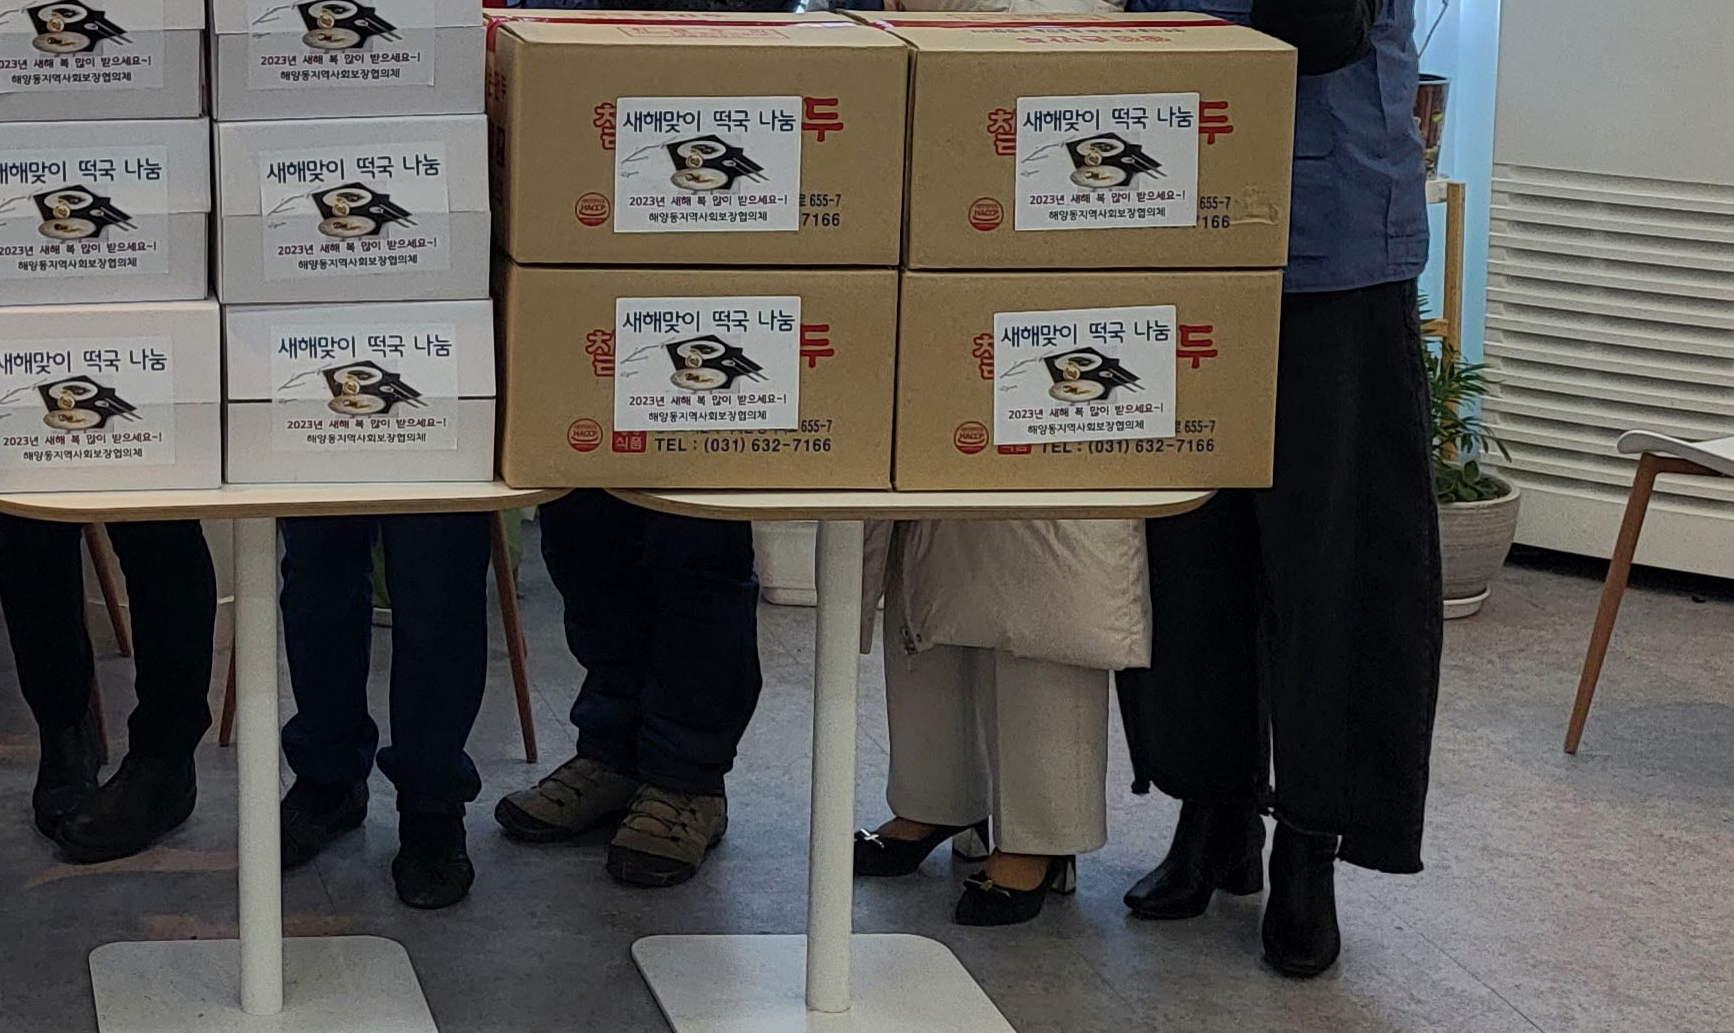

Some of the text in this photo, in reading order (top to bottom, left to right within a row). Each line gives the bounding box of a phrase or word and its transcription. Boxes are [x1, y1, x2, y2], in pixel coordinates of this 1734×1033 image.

[33, 58, 55, 69] 새해
[59, 56, 69, 69] 복
[73, 56, 96, 69] 많이
[11, 72, 132, 86] 해양동지역사회보장협의체
[622, 110, 701, 134] 새해맞이
[713, 109, 751, 133] 떡국
[759, 109, 797, 133] 나눔
[1022, 108, 1100, 133] 새해맞이
[1112, 107, 1149, 131] 떡국
[1157, 106, 1194, 129] 나눔
[78, 159, 117, 183] 떡국
[125, 158, 163, 181] 나눔
[266, 154, 442, 184] 새해맞이 떡국 나눔
[809, 193, 842, 207] 655-7
[1199, 195, 1232, 209] 655-7
[1049, 207, 1166, 222] 해양동지역사회보장협의체
[622, 309, 796, 334] 새해맞이 떡국 나눔
[1000, 319, 1172, 348] 새해맞이 떡국 나눔
[277, 334, 453, 360] 새해맞이 떡국 나눔
[83, 350, 122, 373] 떡국
[129, 349, 168, 371] 나눔
[629, 396, 666, 408] 2023년
[670, 395, 692, 406] 새해
[696, 394, 706, 407] 복
[710, 393, 732, 407] 많이
[648, 410, 767, 424] 해양동지역사회보장협의체
[1008, 408, 1044, 420] 2023년
[1049, 407, 1070, 418] 새해
[1074, 405, 1084, 418] 복
[1088, 404, 1110, 418] 많이
[801, 419, 833, 433] 655-7
[1028, 419, 1144, 436] 해양동지역사회보장협의체
[1183, 419, 1216, 433] 655-7
[307, 433, 427, 447] 해양동지역사회보장협의체
[655, 437, 688, 452] TEL
[703, 437, 746, 454] (031)
[751, 437, 832, 452] 632-7166
[1041, 441, 1072, 454] TEL
[1087, 438, 1130, 455] (031)
[1135, 437, 1215, 453] 632-7166
